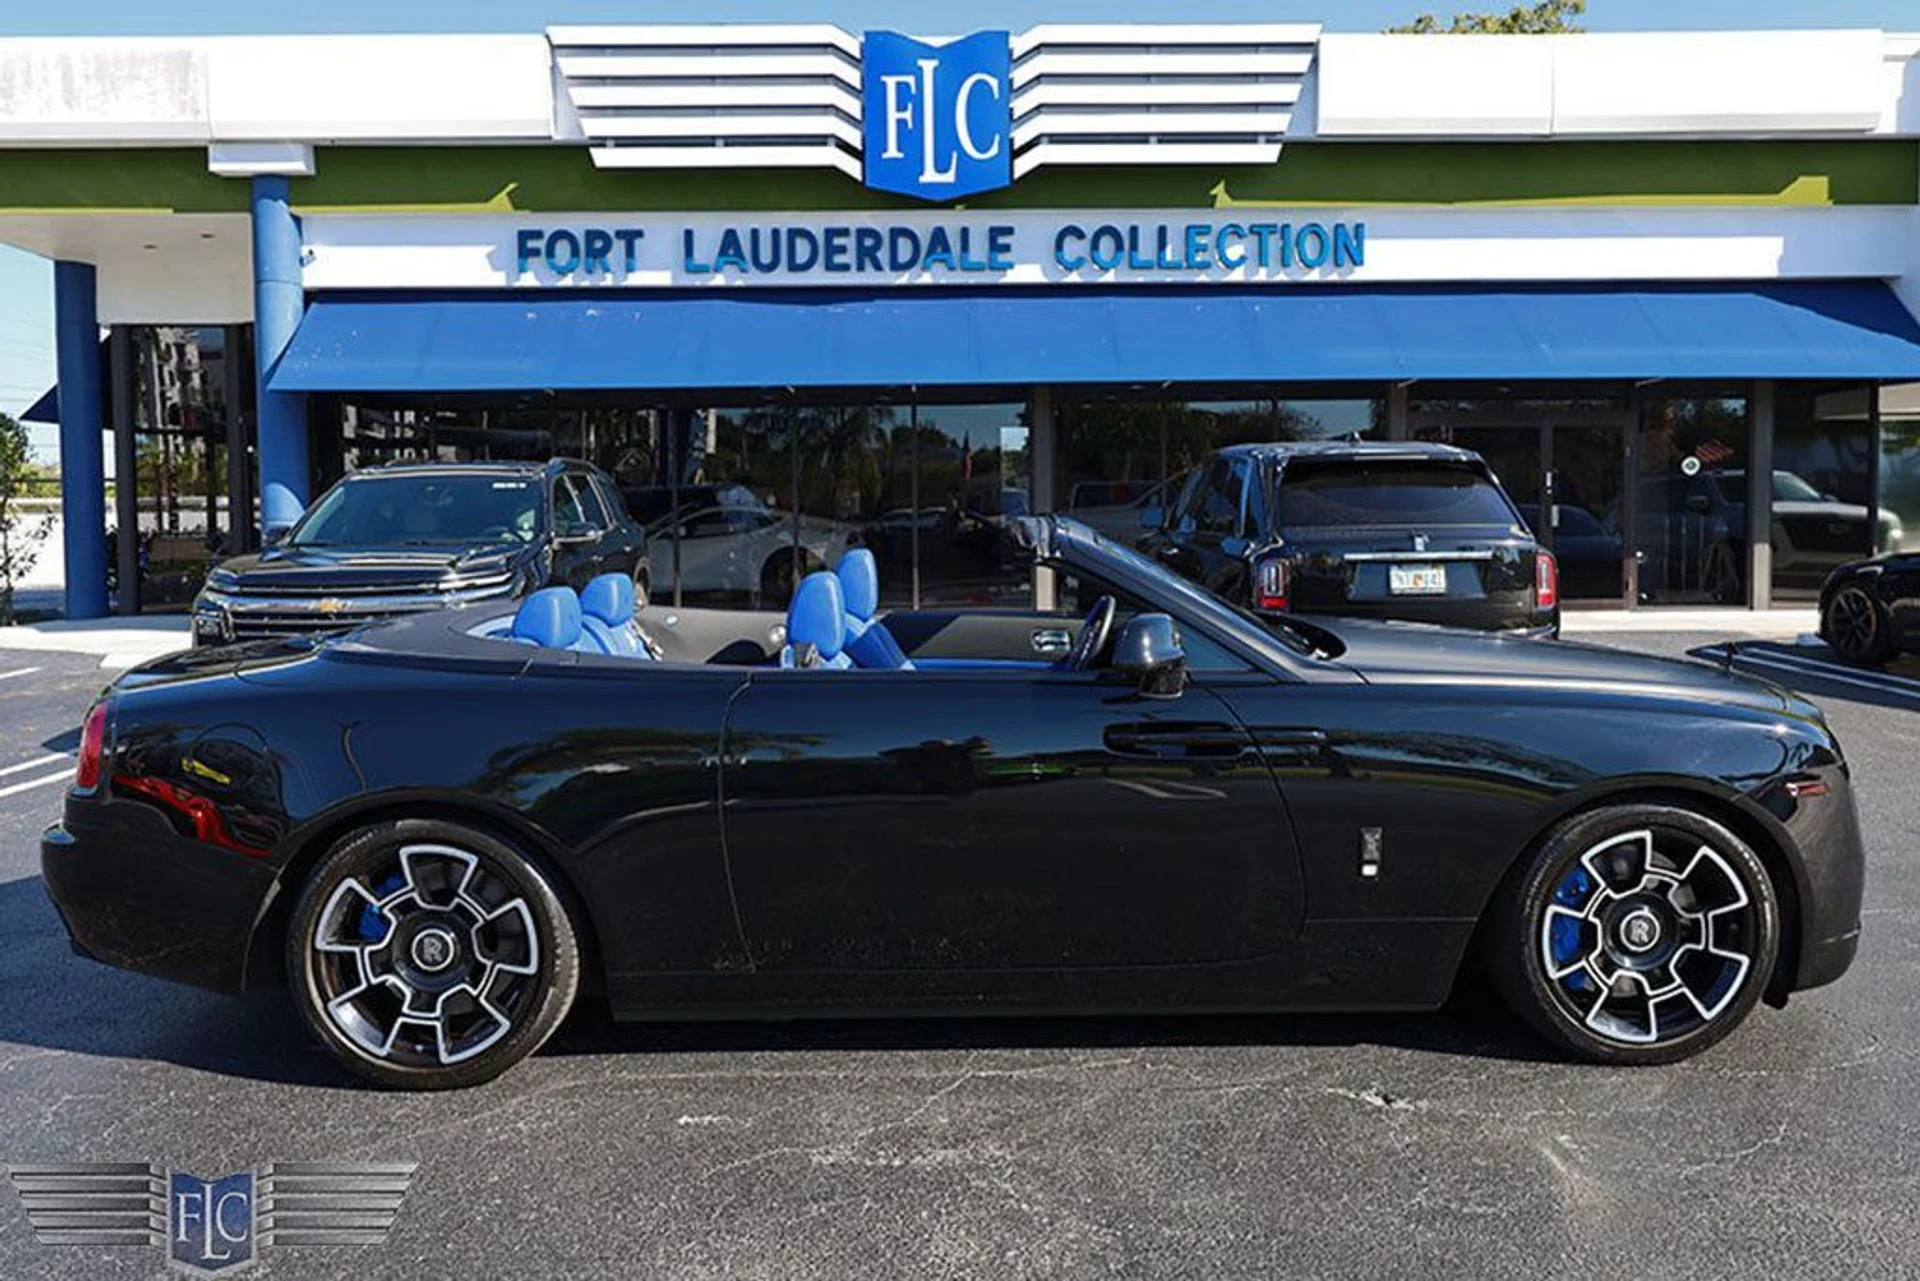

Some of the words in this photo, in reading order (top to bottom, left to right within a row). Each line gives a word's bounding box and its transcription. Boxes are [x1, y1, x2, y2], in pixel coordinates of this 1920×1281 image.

[880, 58, 1000, 184] FLC
[516, 228, 645, 275] FORT
[683, 225, 1016, 274] LAUDERDALE
[1053, 222, 1366, 273] COLLECTION
